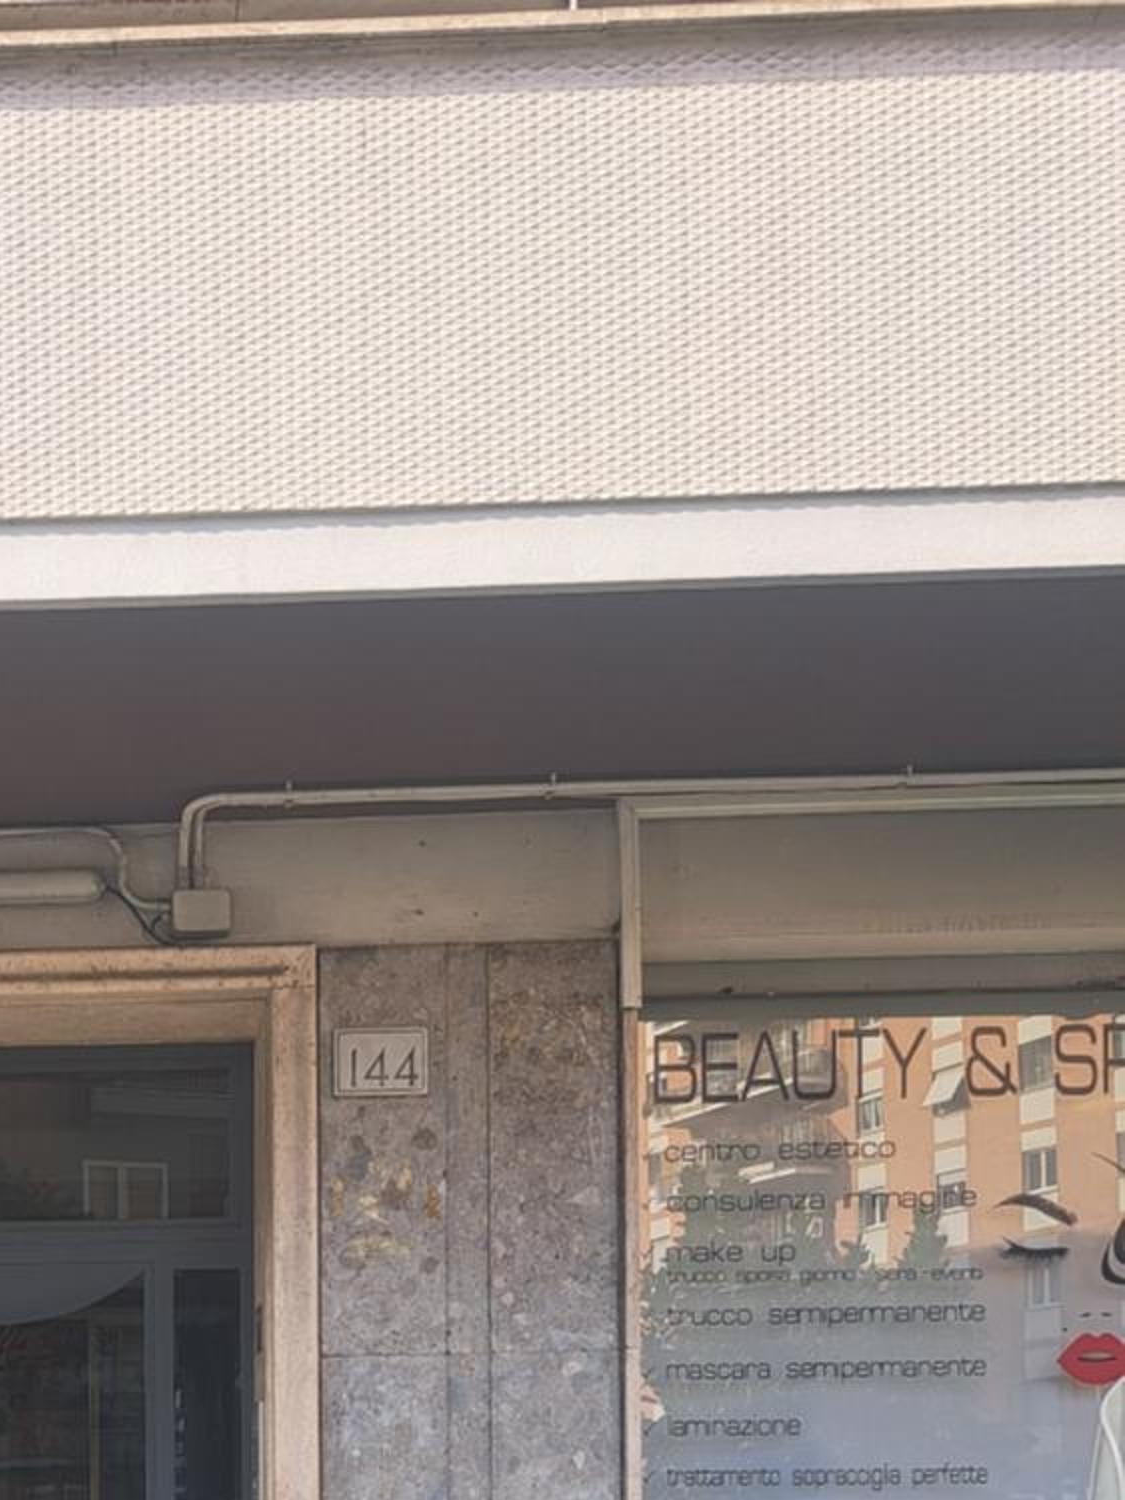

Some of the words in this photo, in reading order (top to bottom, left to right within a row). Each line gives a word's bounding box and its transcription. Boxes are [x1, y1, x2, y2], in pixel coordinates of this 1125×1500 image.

[350, 1046, 419, 1088] 144
[653, 1027, 927, 1103] BEAUTY
[965, 1026, 1017, 1096] &
[664, 1143, 761, 1163] centro
[778, 1139, 896, 1160] estetico
[666, 1190, 824, 1213] consulenza
[665, 1241, 743, 1263] make
[762, 1244, 796, 1266] up
[668, 1307, 753, 1326] trucco
[768, 1303, 986, 1328] semipermanente
[666, 1361, 771, 1380] mascara
[785, 1358, 987, 1382] semipermanente
